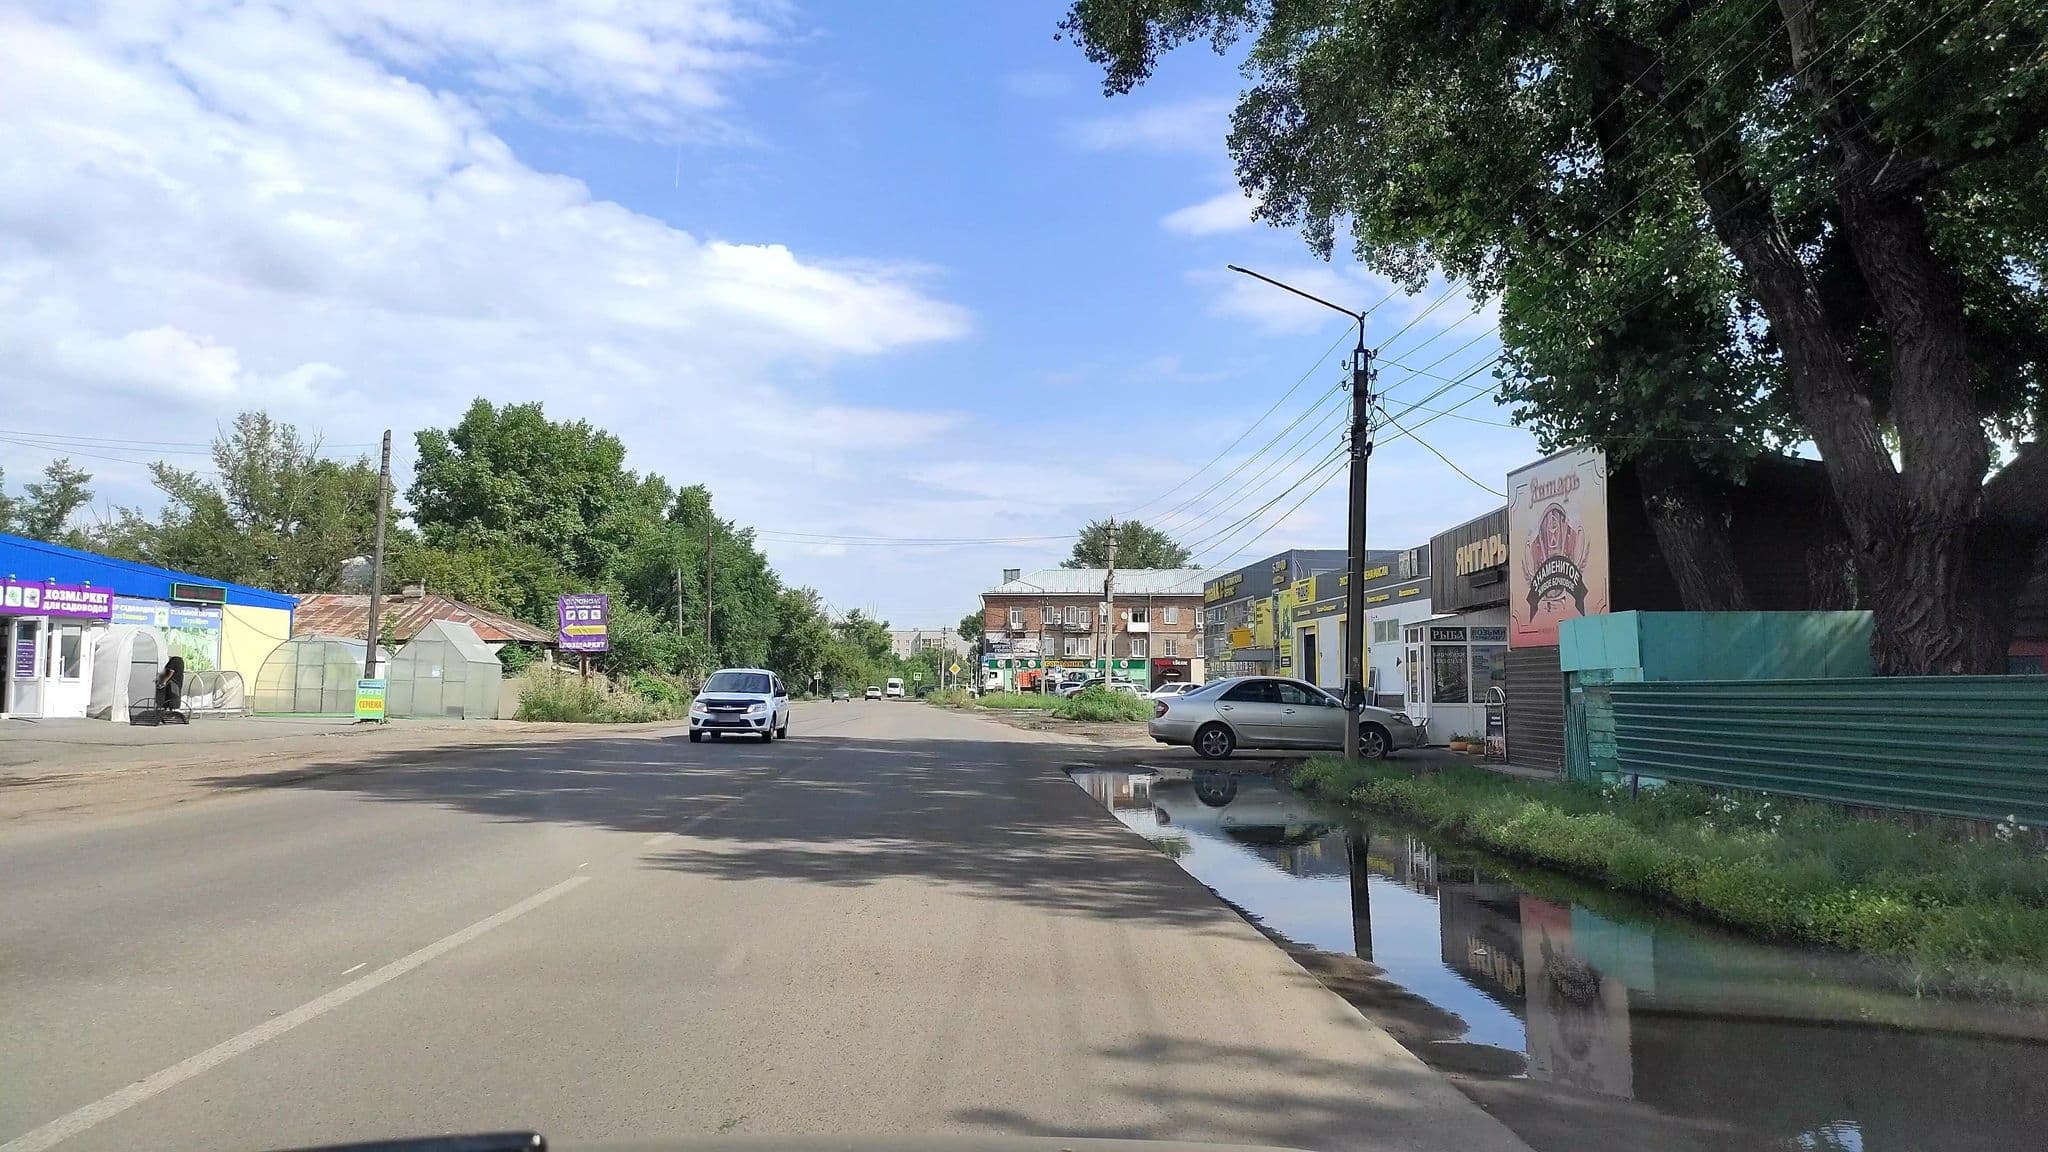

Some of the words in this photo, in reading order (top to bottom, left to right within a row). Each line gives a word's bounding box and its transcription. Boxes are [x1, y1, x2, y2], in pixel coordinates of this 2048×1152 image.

[1529, 473, 1581, 509] Янтарь
[1456, 533, 1507, 576] ЯНТАРЬ
[1533, 560, 1580, 591] ЗНАМЕНИТОЕ
[44, 589, 109, 604] ХОЗМАРКЕТ
[43, 601, 60, 611] ДЛЯ
[61, 603, 108, 613] САДОВОДОВ
[1433, 630, 1465, 640] РЫБА
[359, 700, 382, 709] СЕМЕНА
